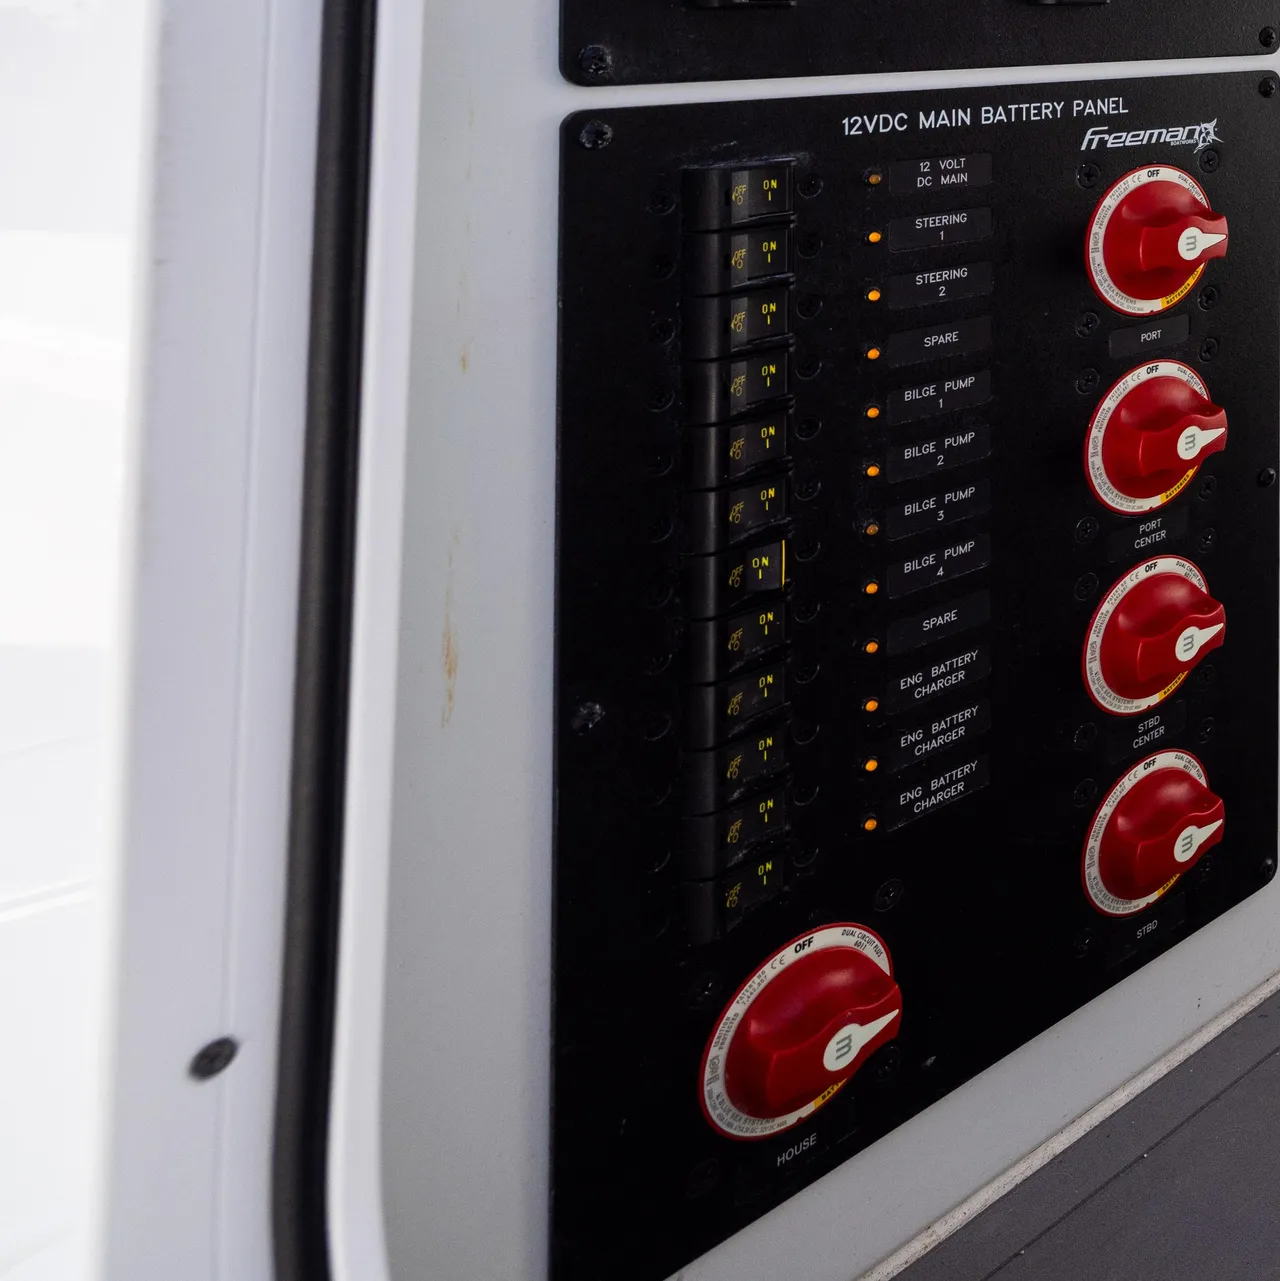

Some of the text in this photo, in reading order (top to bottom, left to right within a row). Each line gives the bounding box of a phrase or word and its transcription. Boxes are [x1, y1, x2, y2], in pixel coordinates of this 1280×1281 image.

[842, 97, 1128, 136] 12VDC MAIN BATTERY PANEL
[920, 158, 966, 172] 12 VOLT
[1147, 169, 1160, 178] OFF
[764, 180, 777, 189] ON
[917, 173, 967, 187] DC MAIN
[916, 213, 967, 229] STEERING
[940, 231, 944, 240] 1
[916, 268, 968, 285] STEERING
[939, 286, 945, 296] 2
[924, 332, 959, 347] SPARE
[1141, 330, 1162, 342] PORT
[1146, 365, 1159, 375] OFF
[905, 376, 975, 401] BILGE PUMP
[939, 399, 943, 408] 1
[905, 432, 975, 459] BILGE PUMP
[937, 455, 944, 465] 2
[905, 487, 975, 515] BILGE PUMP
[937, 511, 944, 521] 3
[1140, 518, 1162, 534] PORT
[1134, 530, 1166, 549] CENTER
[904, 541, 975, 573] BILGE PUMP
[937, 567, 944, 576] 4
[1145, 562, 1158, 573] OFF
[923, 610, 957, 631] SPARE
[900, 650, 979, 690] ENG BATTERY
[914, 671, 965, 698] CHARGER
[901, 706, 979, 747] ENG BATTERY
[1138, 715, 1160, 733] STBD
[915, 727, 965, 756] CHARGER
[1133, 726, 1165, 748] CENTER
[1143, 758, 1157, 770] OFF
[900, 761, 978, 805] ENG BATTERY
[914, 782, 964, 813] CHARGER
[1137, 920, 1158, 938] STBD
[794, 937, 814, 954] OFF
[777, 1133, 817, 1167] HOUSE
